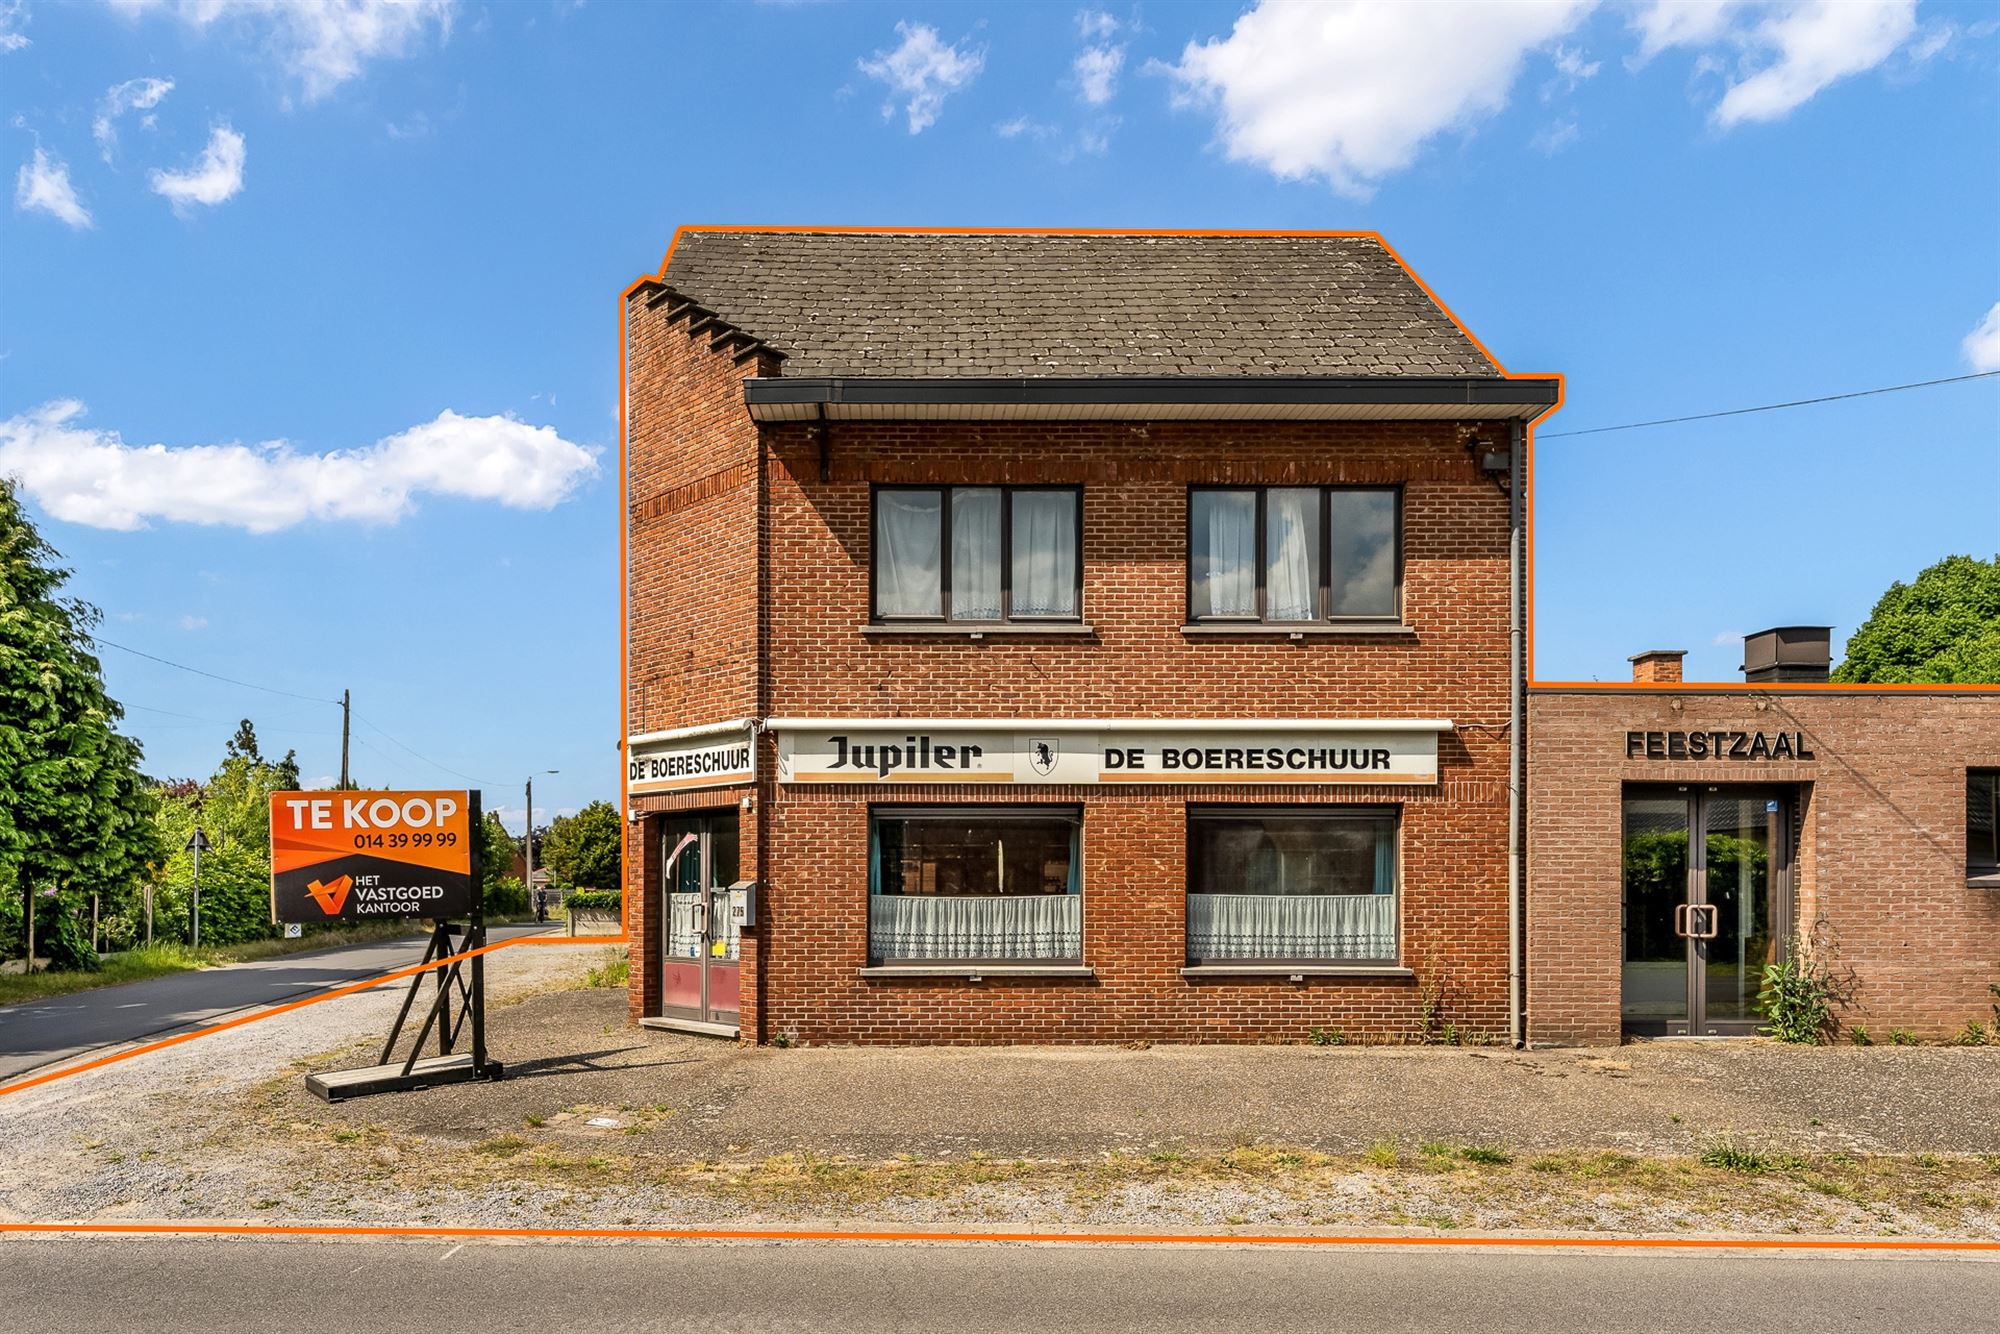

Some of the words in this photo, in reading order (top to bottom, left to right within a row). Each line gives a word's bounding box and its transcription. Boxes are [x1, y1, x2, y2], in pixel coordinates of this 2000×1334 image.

[1625, 731, 1815, 759] FEESTZAAL
[630, 761, 645, 781] DE
[651, 748, 750, 778] BOERESCHUUR
[826, 736, 982, 778] Jupiler
[1105, 748, 1144, 769] DE
[1161, 747, 1391, 770] BOERESCHUUR
[286, 799, 333, 830] TE
[344, 798, 457, 829] KOOP
[354, 834, 384, 848] 014
[388, 833, 408, 848] 39
[412, 833, 433, 847] 99
[436, 832, 457, 847] 99
[355, 875, 380, 886] HET
[355, 886, 444, 901] VASTGOED
[356, 902, 420, 914] KANTOOR
